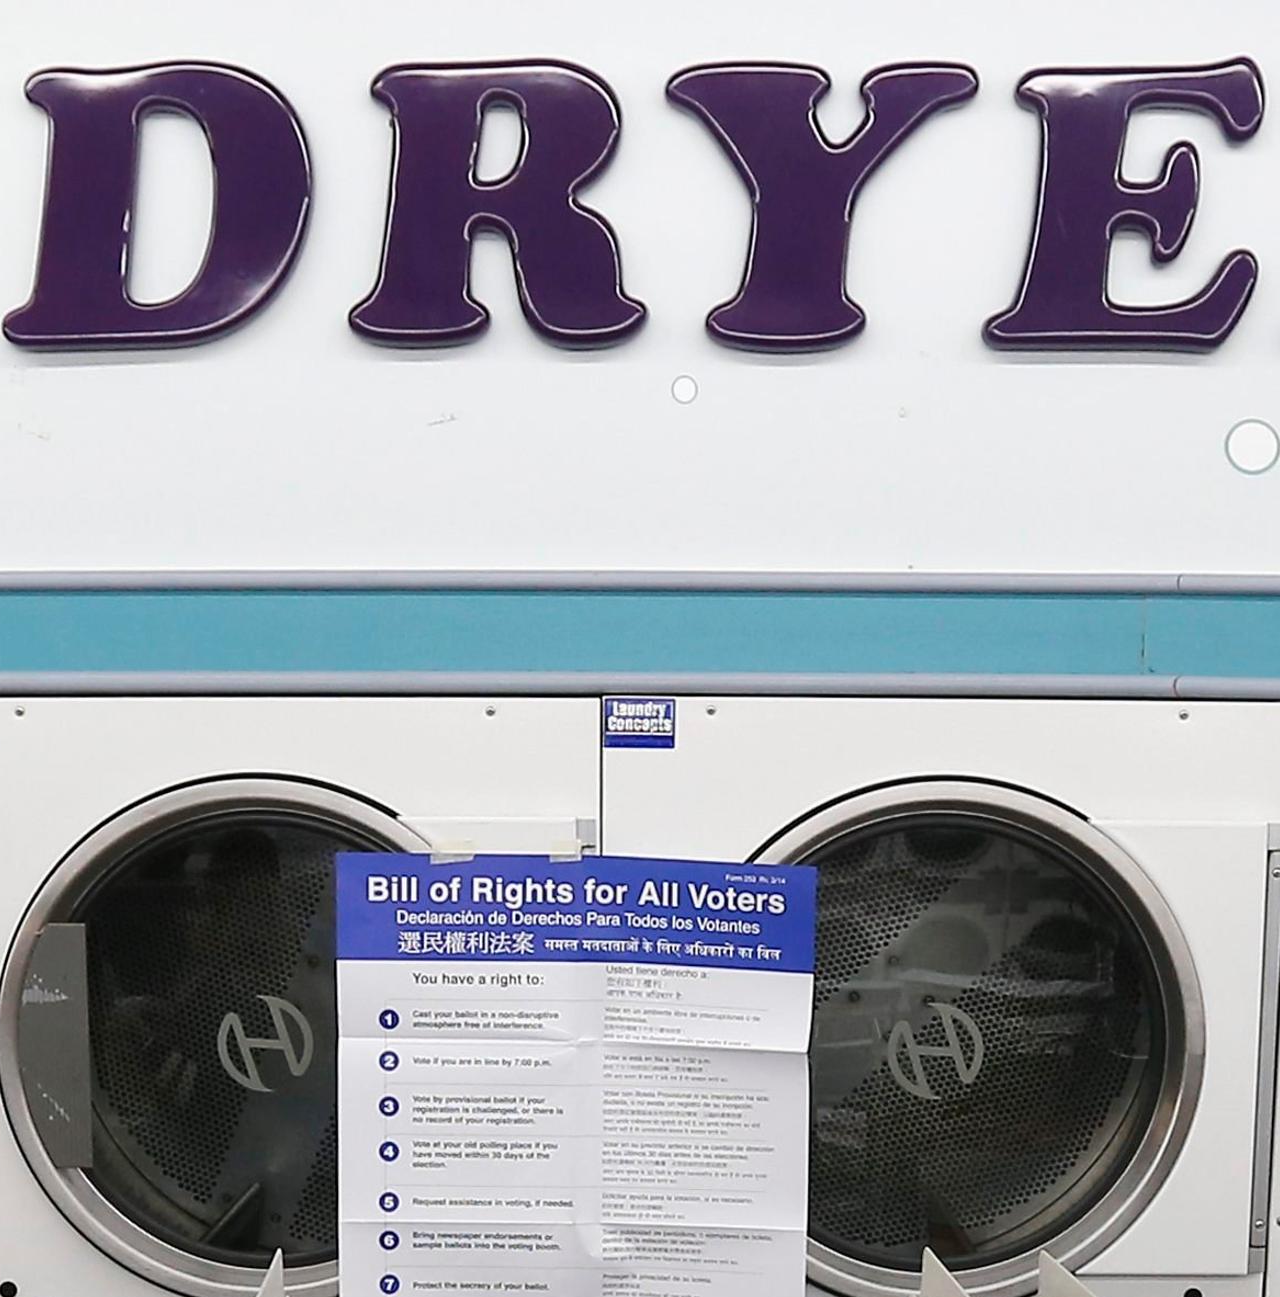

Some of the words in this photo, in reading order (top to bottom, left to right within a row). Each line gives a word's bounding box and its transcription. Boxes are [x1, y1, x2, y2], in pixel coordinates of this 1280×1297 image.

[612, 701, 666, 718] Laundry
[607, 716, 672, 733] Concepts
[368, 876, 418, 902] Bill
[430, 877, 461, 902] of
[473, 877, 574, 909] Rights
[584, 878, 628, 904] for
[638, 881, 679, 907] All
[688, 882, 786, 914] Voters
[397, 909, 484, 925] Declaración
[488, 911, 506, 925] de
[512, 911, 582, 926] Derechos
[587, 912, 620, 927] Para
[625, 913, 668, 929] Todos
[672, 915, 693, 930] los
[697, 917, 760, 934] Votantes
[398, 931, 535, 954] 選民權利法案
[606, 965, 634, 975] Usted
[636, 966, 658, 976] tiene
[661, 967, 698, 979] derecho
[412, 973, 437, 985] You
[442, 973, 474, 985] have
[479, 976, 486, 985] a
[491, 973, 521, 987] right
[527, 974, 544, 985] to:
[434, 1012, 453, 1020] your
[413, 1057, 431, 1065] Vote
[441, 1059, 456, 1067] you
[502, 1058, 512, 1068] by
[413, 1095, 431, 1103] Vote
[433, 1096, 443, 1104] by
[493, 1096, 517, 1104] ballot
[527, 1098, 545, 1106] your
[533, 1107, 554, 1115] there
[557, 1107, 564, 1115] is
[426, 1116, 452, 1124] record
[465, 1118, 484, 1126] your
[413, 1281, 443, 1289] Protect
[445, 1281, 458, 1289] the
[493, 1281, 502, 1289] of
[504, 1283, 523, 1291] your
